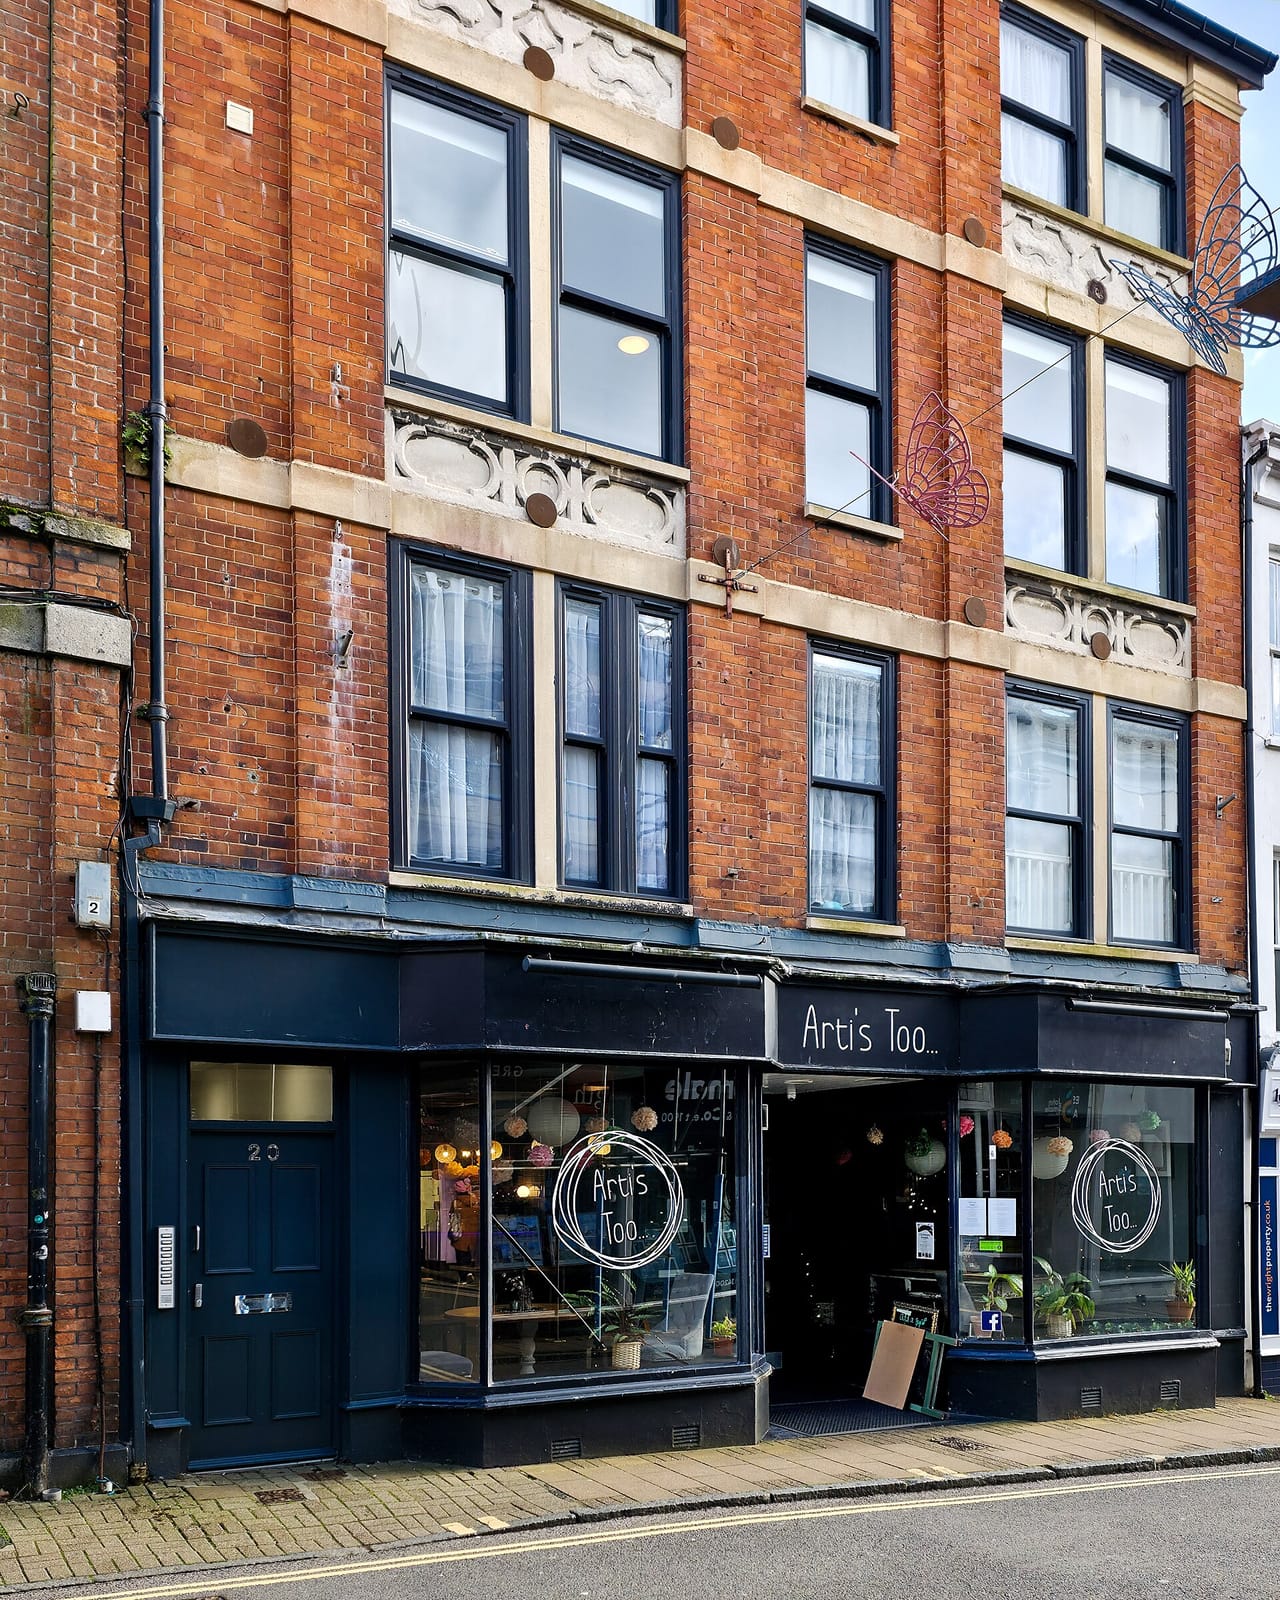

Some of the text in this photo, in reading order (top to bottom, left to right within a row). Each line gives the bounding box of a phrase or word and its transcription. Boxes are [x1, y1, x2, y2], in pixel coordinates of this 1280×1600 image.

[89, 902, 98, 914] 2
[802, 1004, 872, 1052] Arti's
[248, 1143, 280, 1161] 20
[1099, 1165, 1137, 1198] Arti's
[1264, 1199, 1273, 1313] thewrightproperty.co.uk
